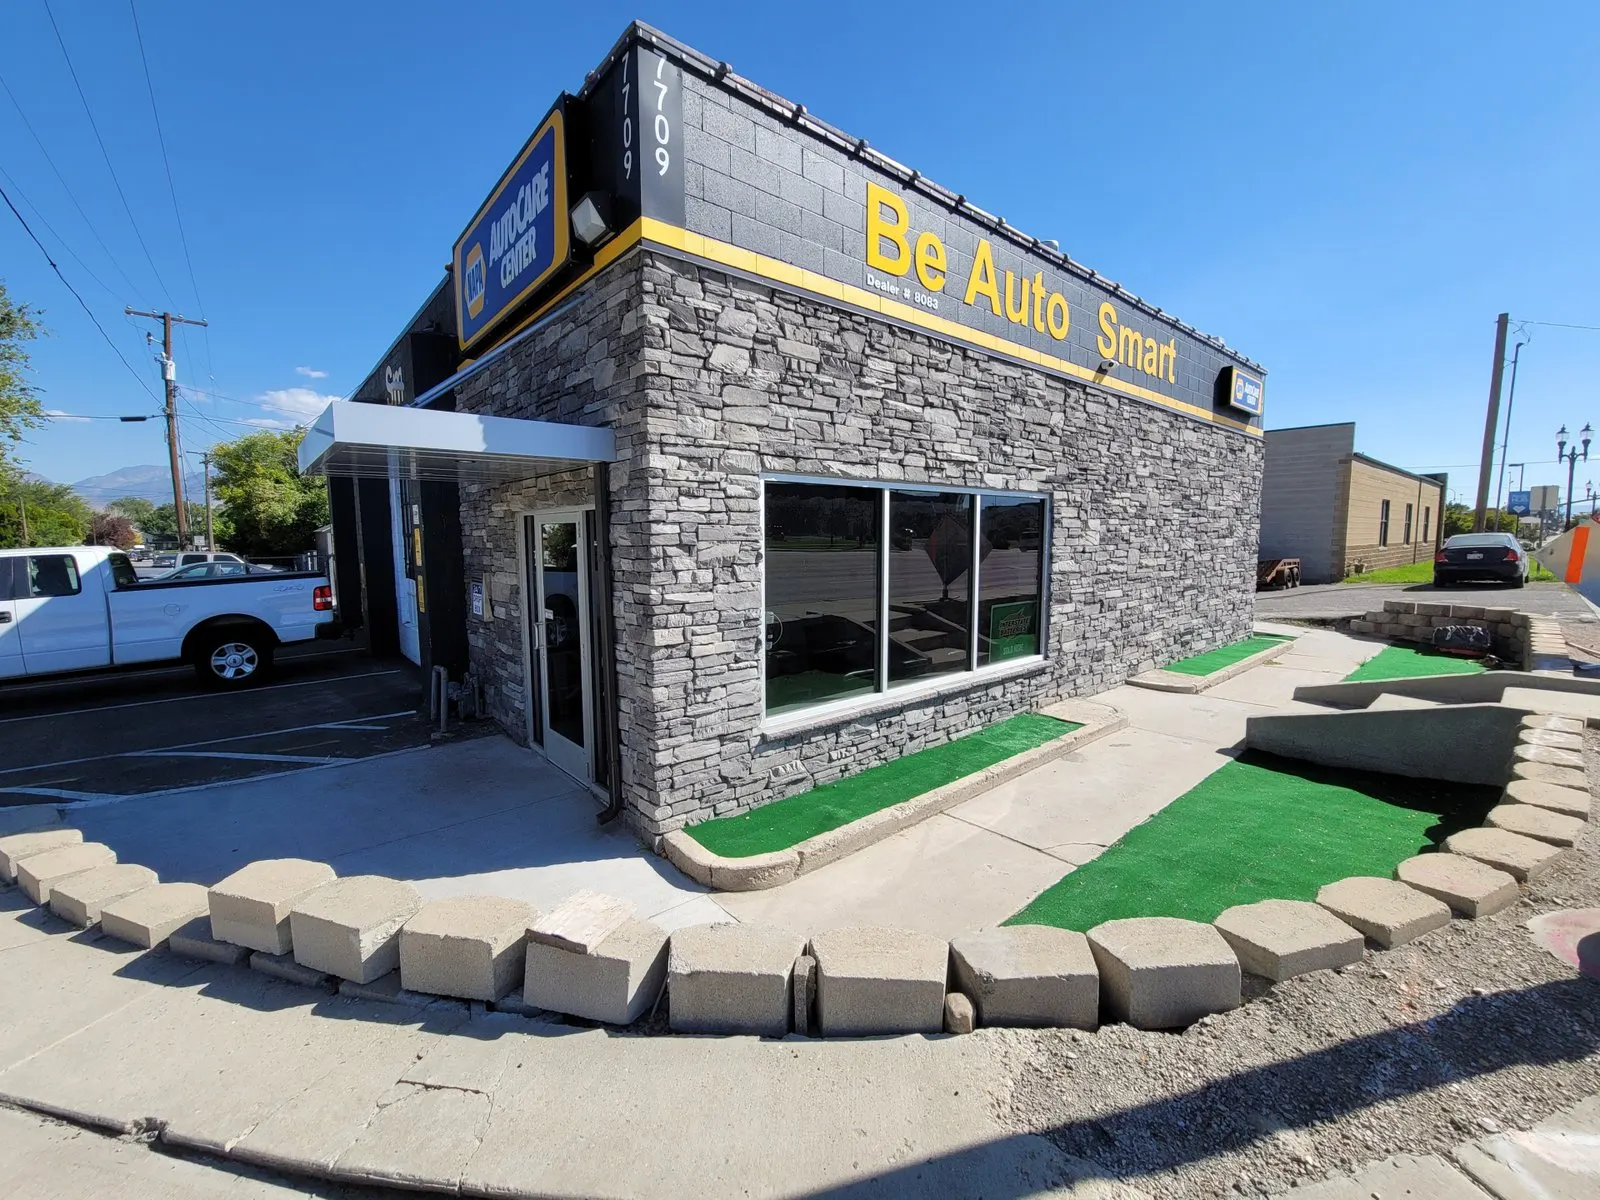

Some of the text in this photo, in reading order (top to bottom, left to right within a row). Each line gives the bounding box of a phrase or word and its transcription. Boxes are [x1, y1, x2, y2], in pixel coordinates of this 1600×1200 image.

[622, 50, 632, 180] 7709
[653, 48, 670, 177] 7709
[466, 259, 485, 304] NAPA
[500, 225, 537, 289] CENTER
[866, 181, 1177, 385] Be Auto Smart
[867, 272, 939, 310] Dealer # 8083
